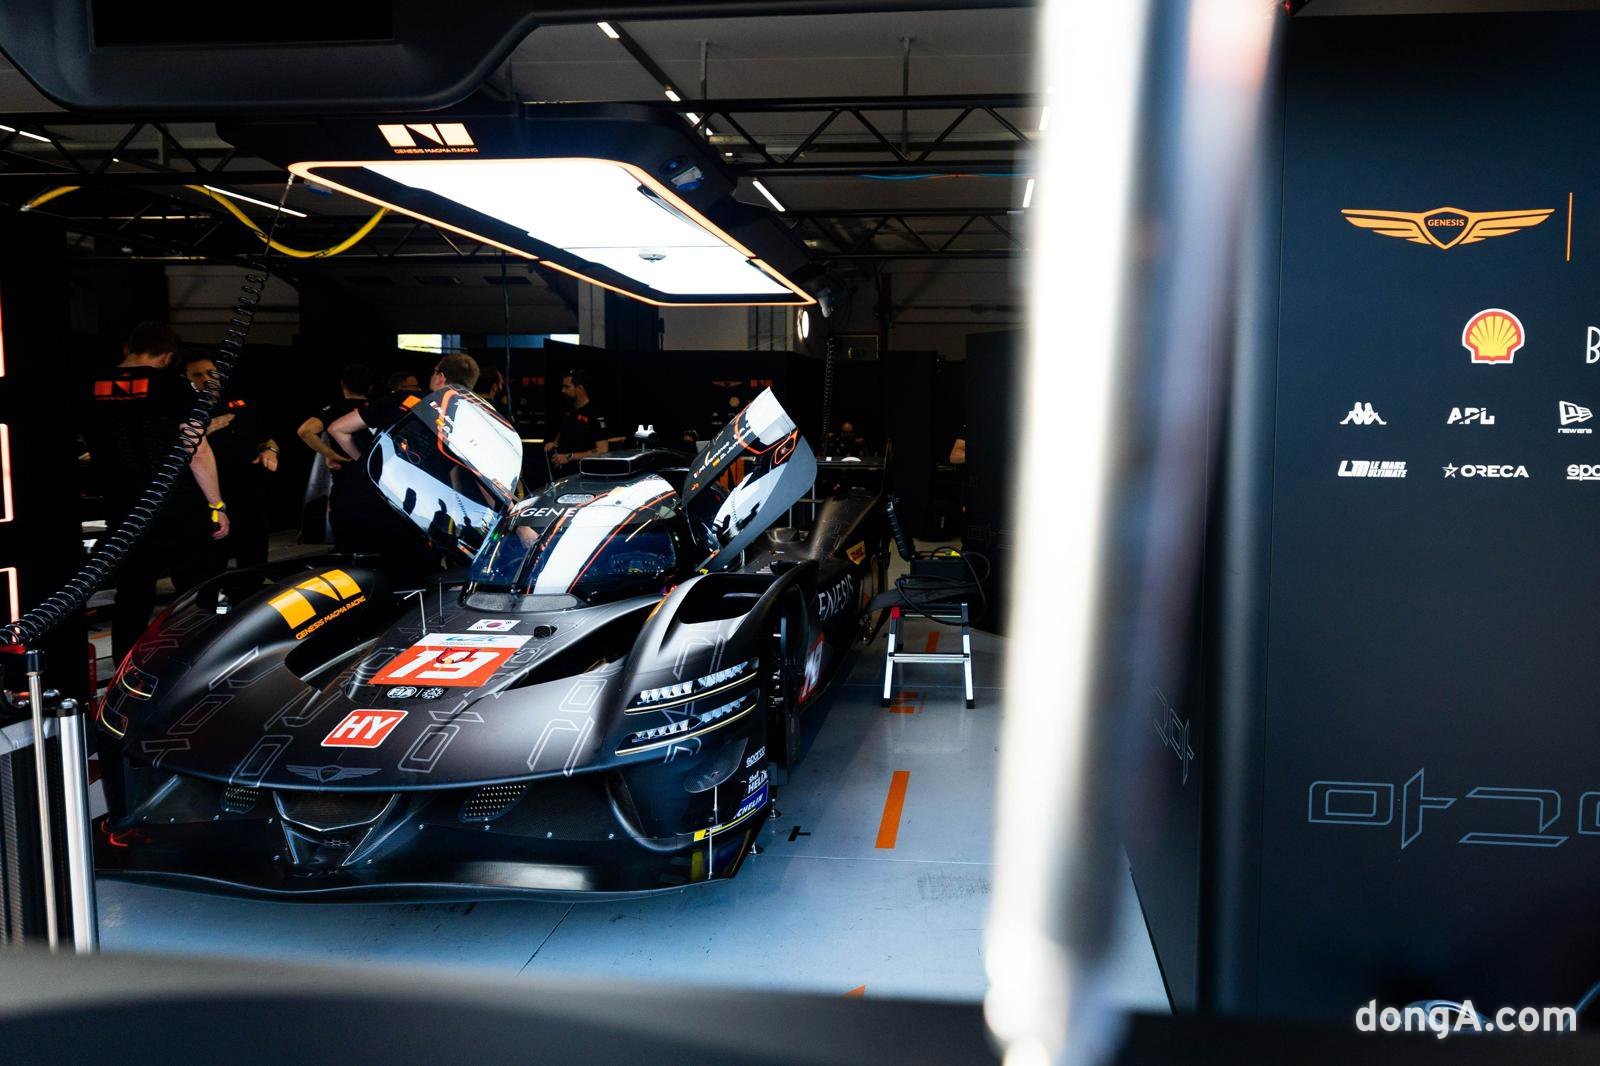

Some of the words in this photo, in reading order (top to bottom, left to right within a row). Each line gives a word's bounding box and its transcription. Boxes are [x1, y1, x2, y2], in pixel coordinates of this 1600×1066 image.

[1427, 219, 1465, 228] GENESIS
[1446, 407, 1496, 425] APL
[1460, 464, 1530, 478] ORECA
[296, 618, 325, 640] GENESIS
[323, 605, 347, 623] MAGMA
[387, 649, 501, 680] 19
[332, 715, 400, 740] HY
